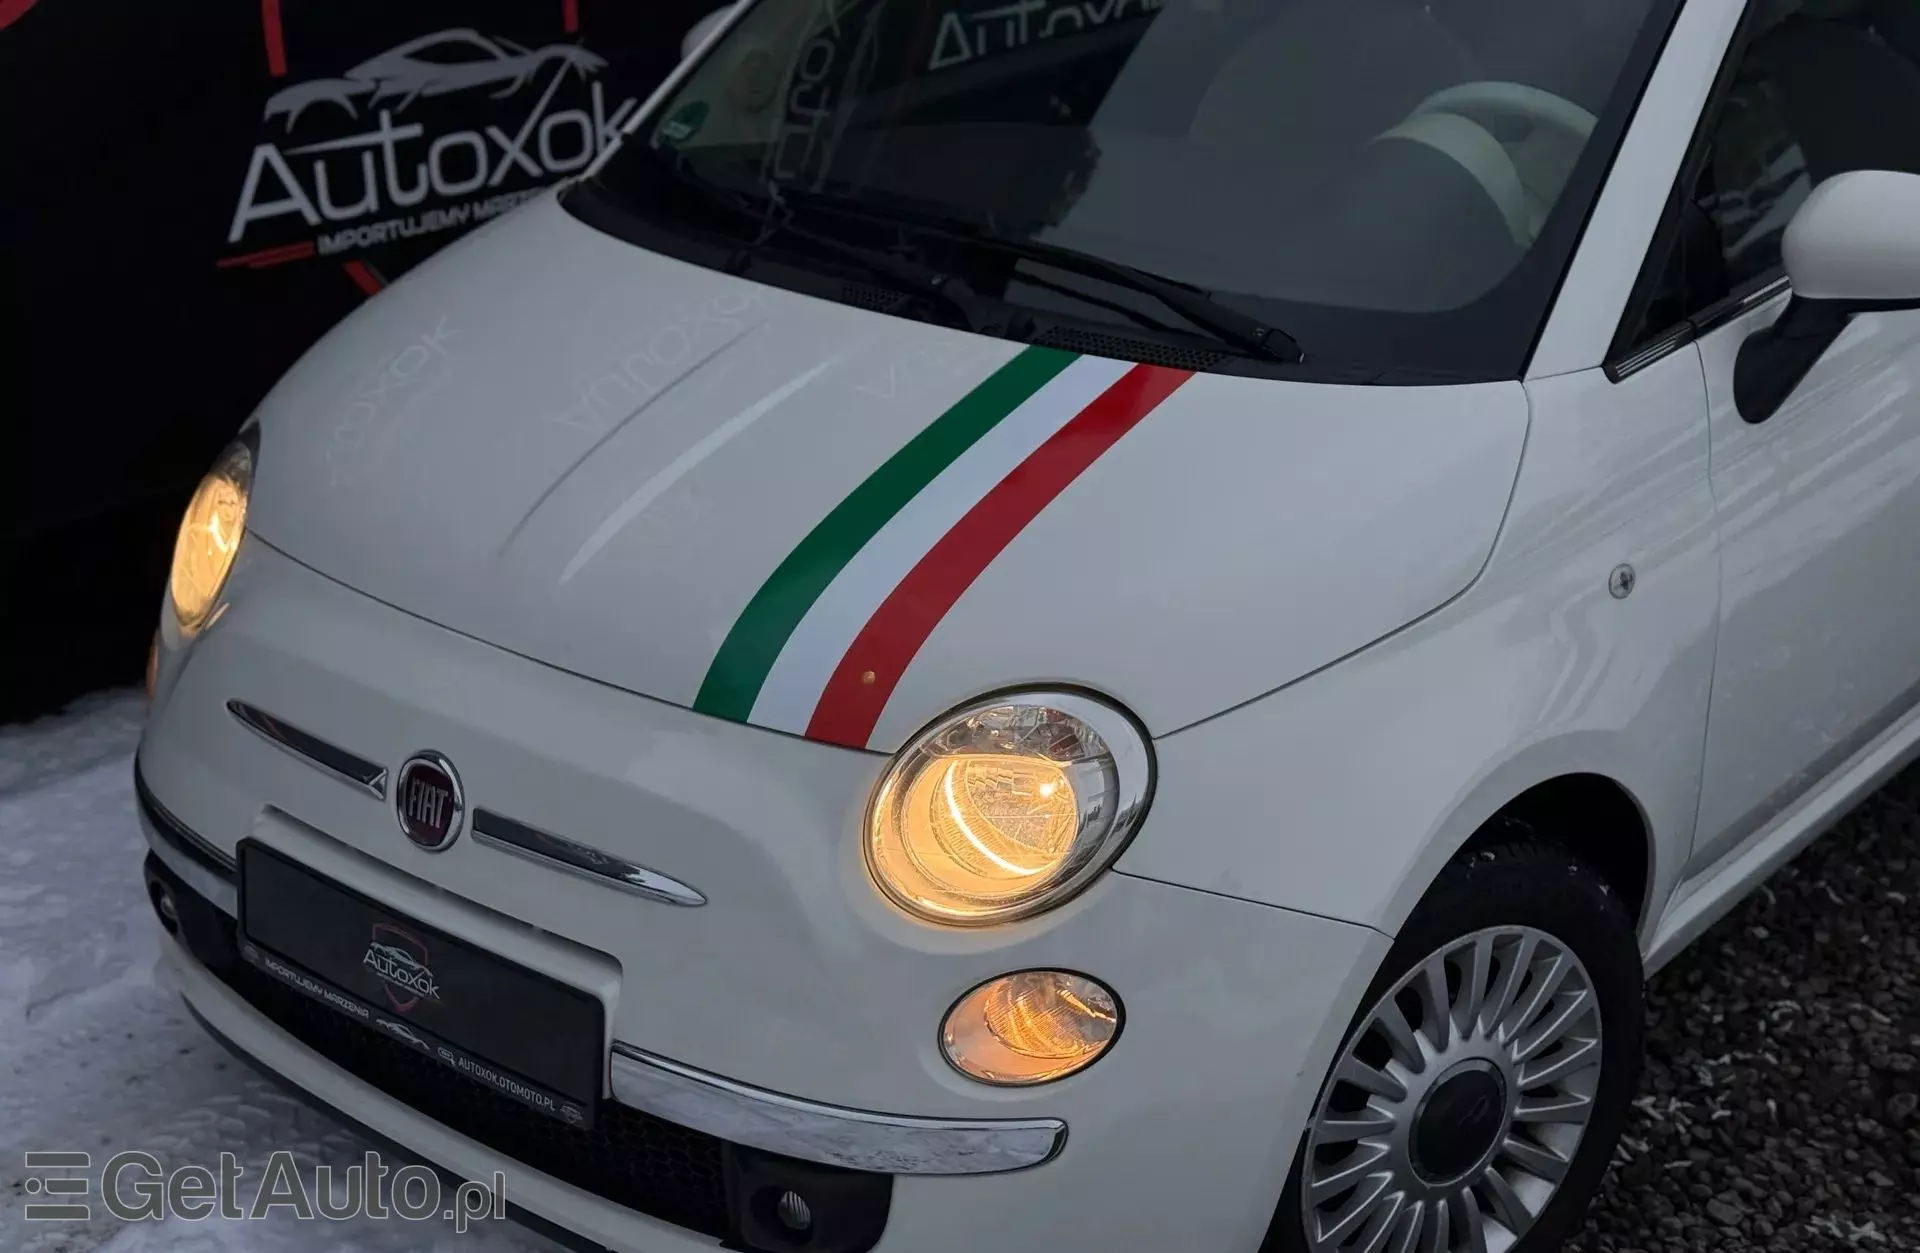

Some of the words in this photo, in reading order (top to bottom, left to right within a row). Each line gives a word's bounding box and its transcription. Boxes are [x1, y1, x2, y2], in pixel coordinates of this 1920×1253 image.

[228, 62, 637, 243] Autoxok
[317, 208, 472, 256] IMPORTUJEMY
[408, 777, 449, 829] FIAT
[363, 949, 440, 999] Autoxok
[458, 1056, 556, 1112] AUTOXOK.OTOMOTO.PL
